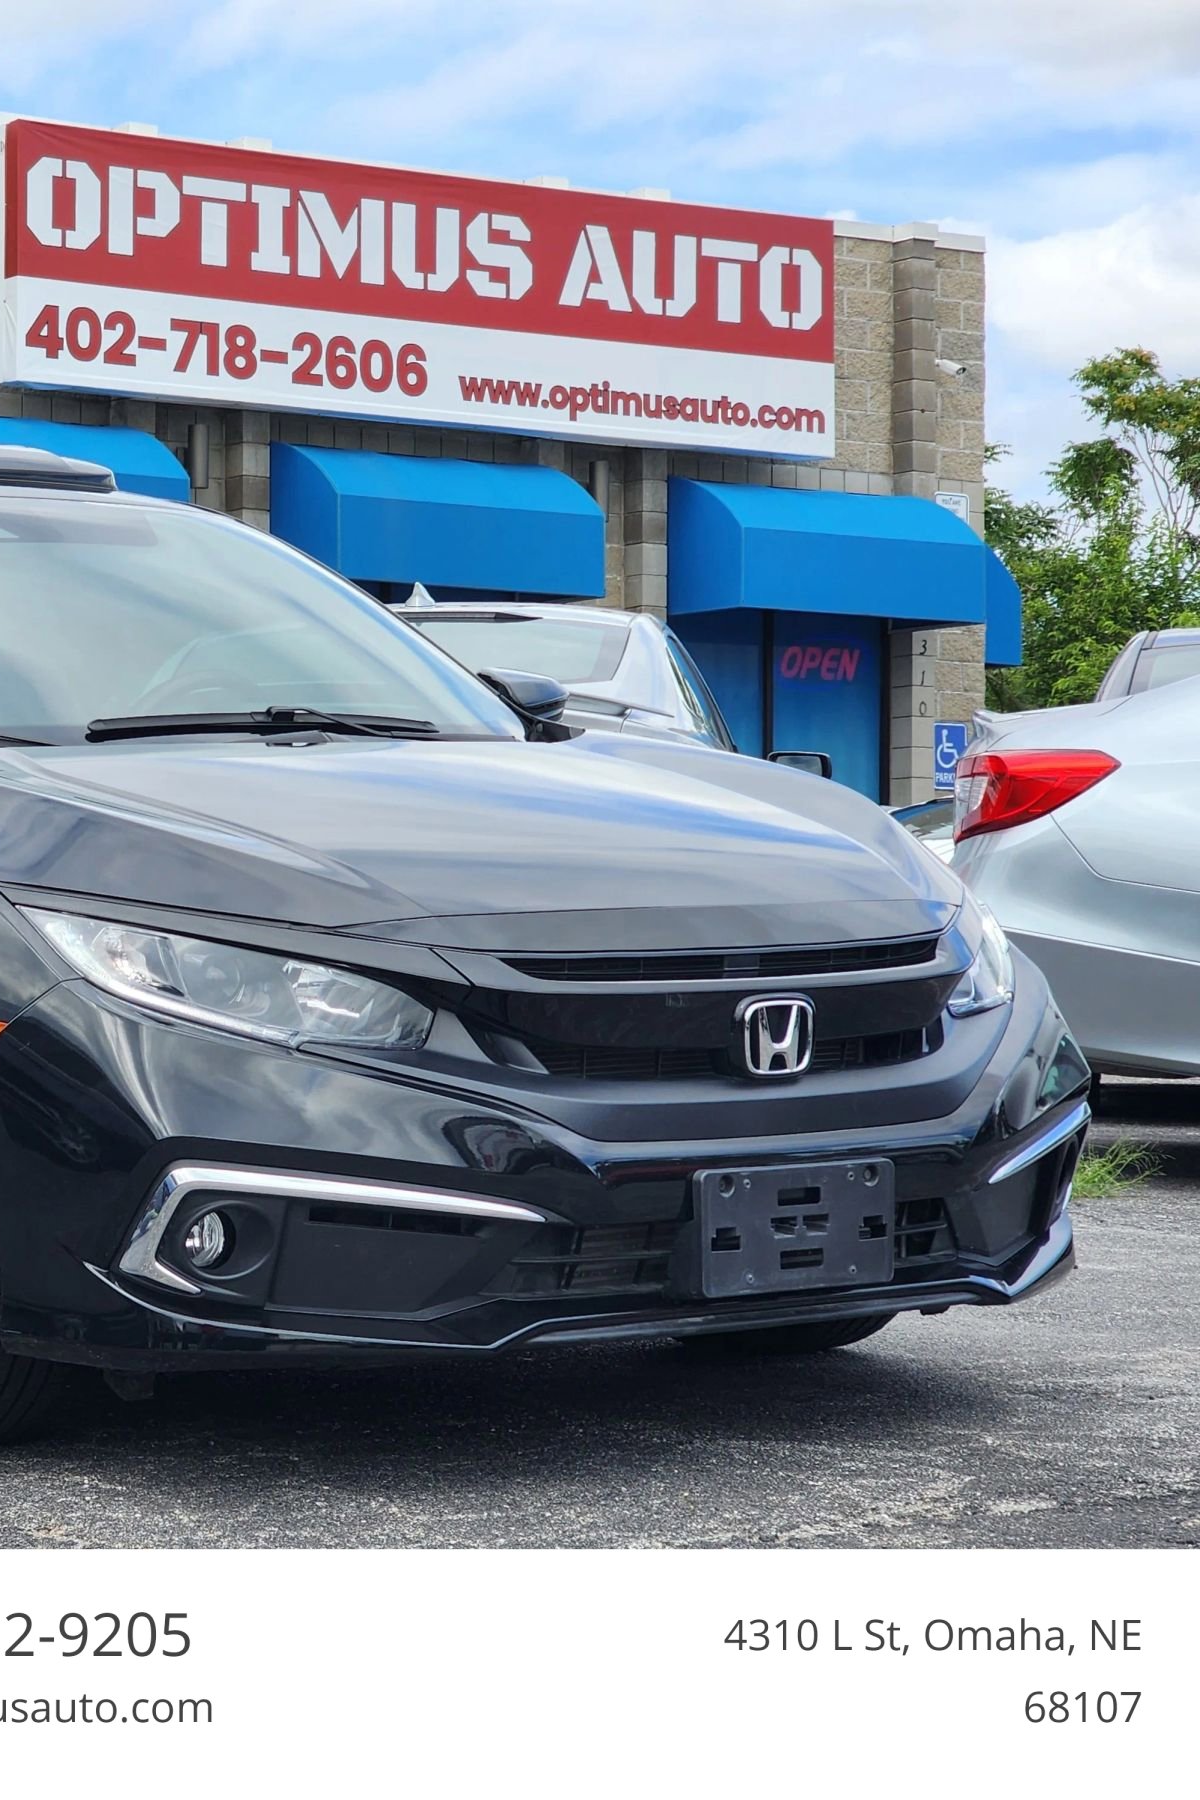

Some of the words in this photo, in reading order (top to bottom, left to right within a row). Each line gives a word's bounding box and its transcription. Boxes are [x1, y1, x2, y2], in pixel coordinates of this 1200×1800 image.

[26, 156, 534, 302] OPTIMUS
[559, 224, 823, 331] AUTO
[25, 304, 428, 396] 402-718-2606
[458, 375, 825, 434] www.optimusauto.com
[781, 646, 860, 682] OPEN
